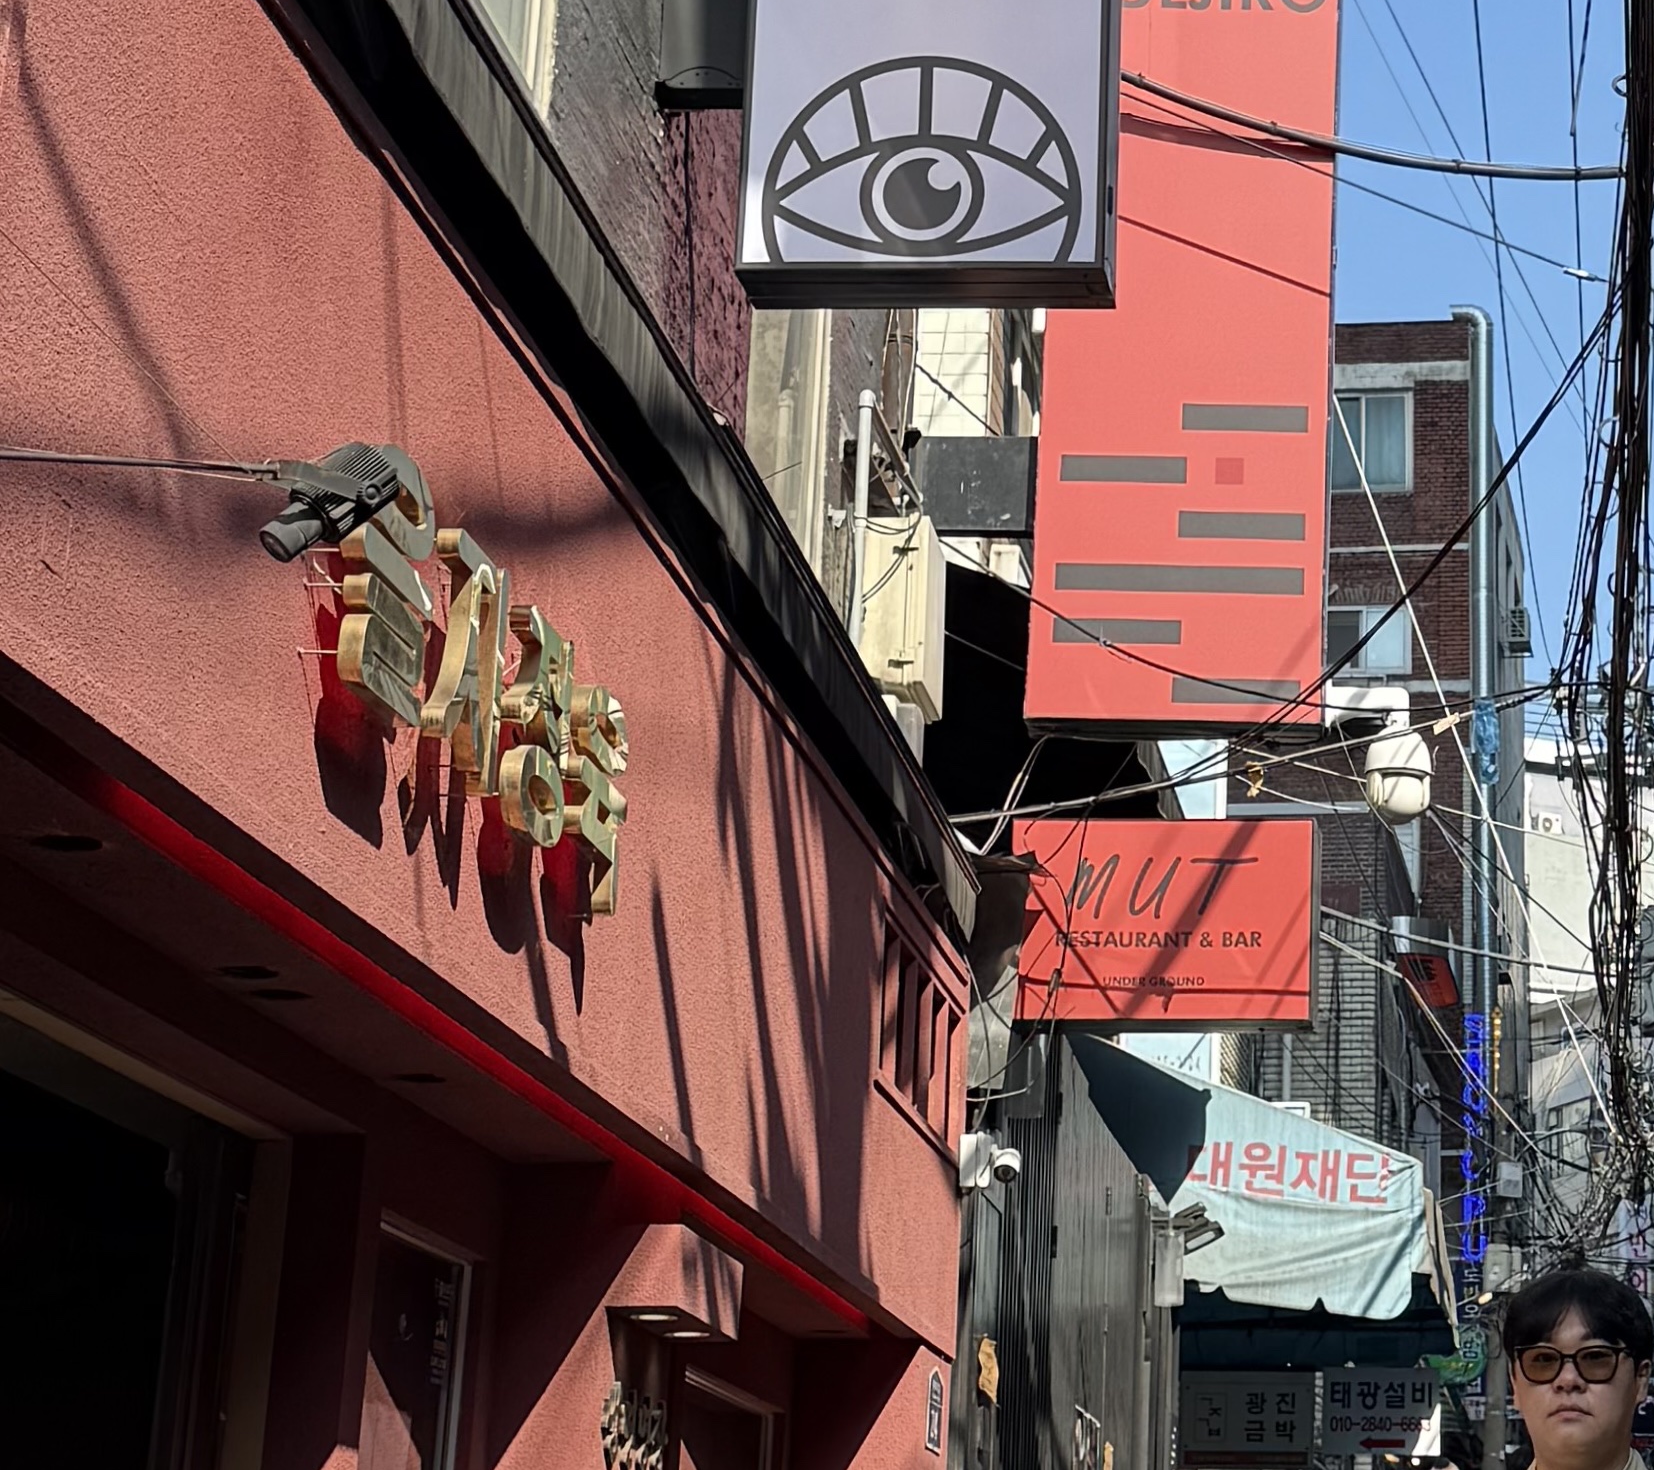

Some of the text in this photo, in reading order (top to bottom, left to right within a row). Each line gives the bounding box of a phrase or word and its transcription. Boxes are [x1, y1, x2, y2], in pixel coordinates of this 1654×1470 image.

[1066, 852, 1259, 920] MUT
[1055, 930, 1263, 949] RESTAURANT & BAR
[1330, 1381, 1434, 1410] 태광설비
